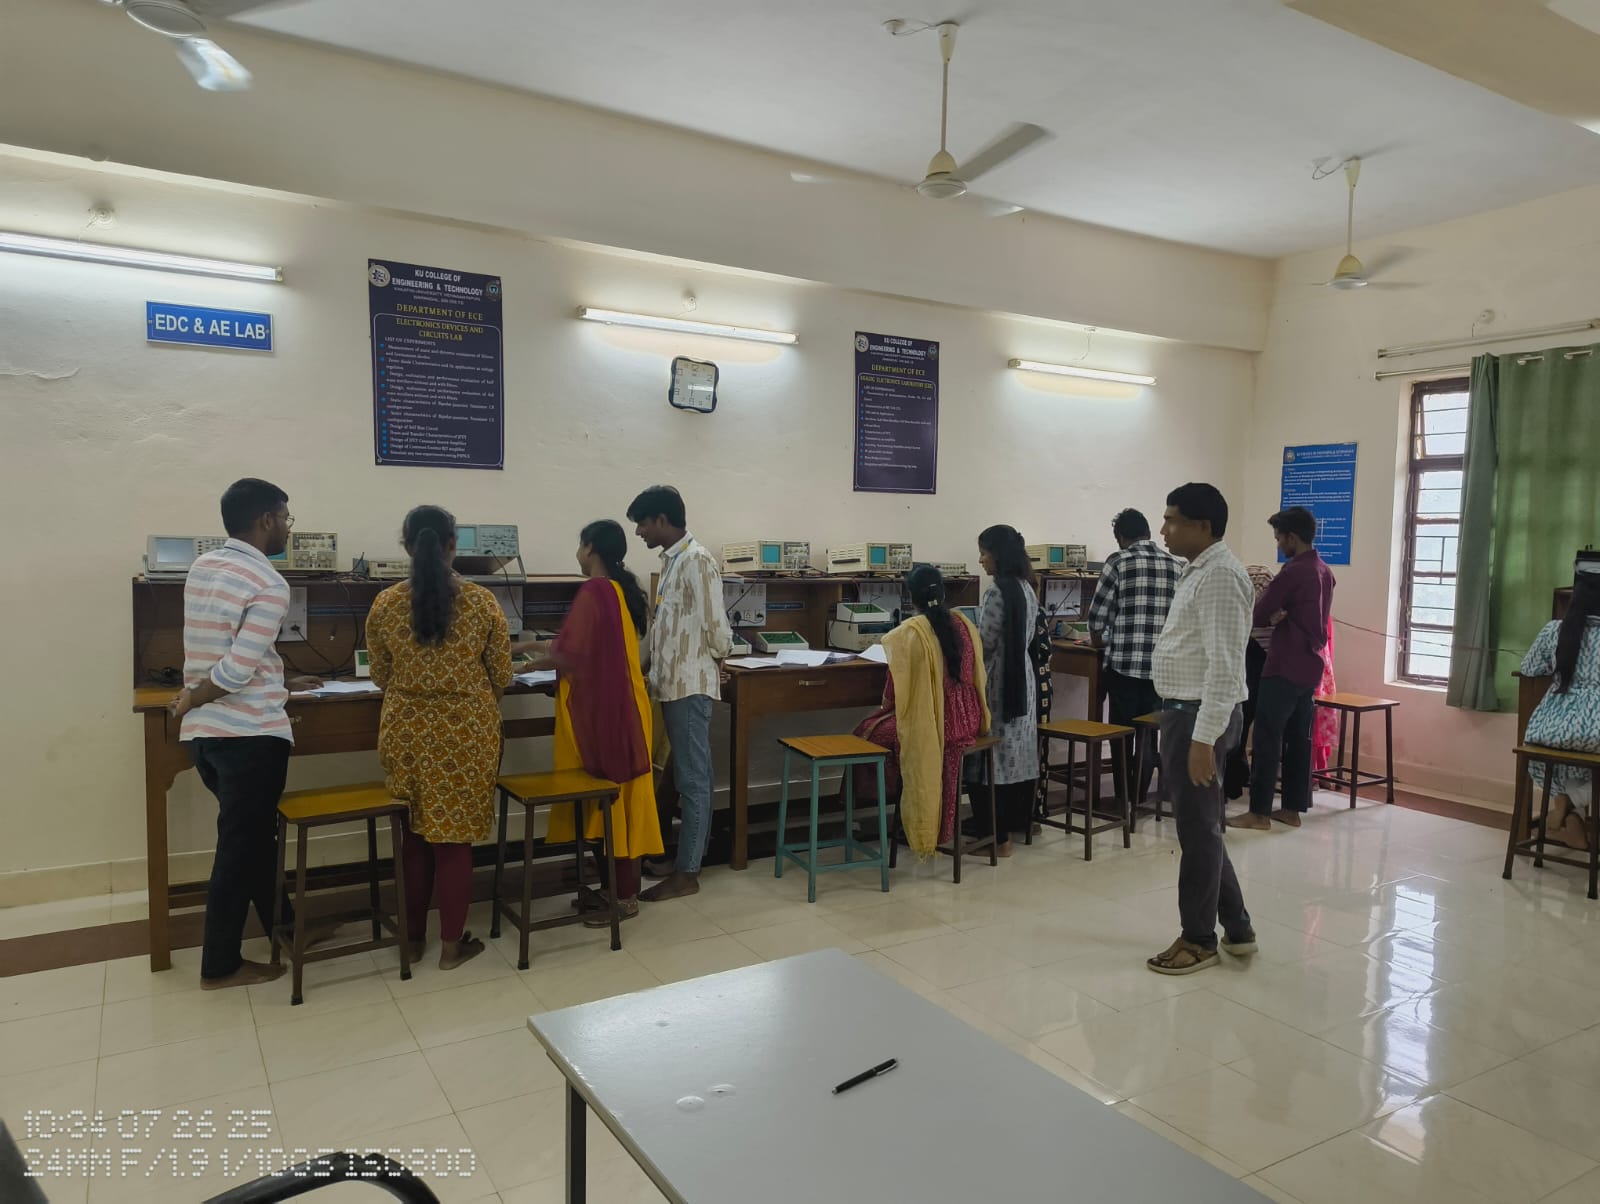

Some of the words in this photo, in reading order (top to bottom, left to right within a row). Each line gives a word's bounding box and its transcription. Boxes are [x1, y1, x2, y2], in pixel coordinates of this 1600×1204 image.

[425, 270, 453, 282] COLLEGE
[453, 274, 461, 282] OF
[391, 277, 433, 290] ENGINEERING
[444, 284, 483, 297] TECHNOLOGY
[396, 303, 453, 317] DEPARTMENT
[454, 310, 466, 318] OF
[468, 312, 483, 321] ECE
[155, 313, 189, 333] EDC
[193, 317, 205, 335] &
[209, 319, 231, 337] AE
[235, 321, 266, 340] LAB
[396, 317, 441, 330] ELECTRONICS
[441, 322, 469, 333] DEVICES
[470, 325, 484, 334] AND
[418, 330, 449, 340] CIRCUITS
[449, 332, 463, 341] LAB
[871, 364, 906, 373] DEPARTMENT
